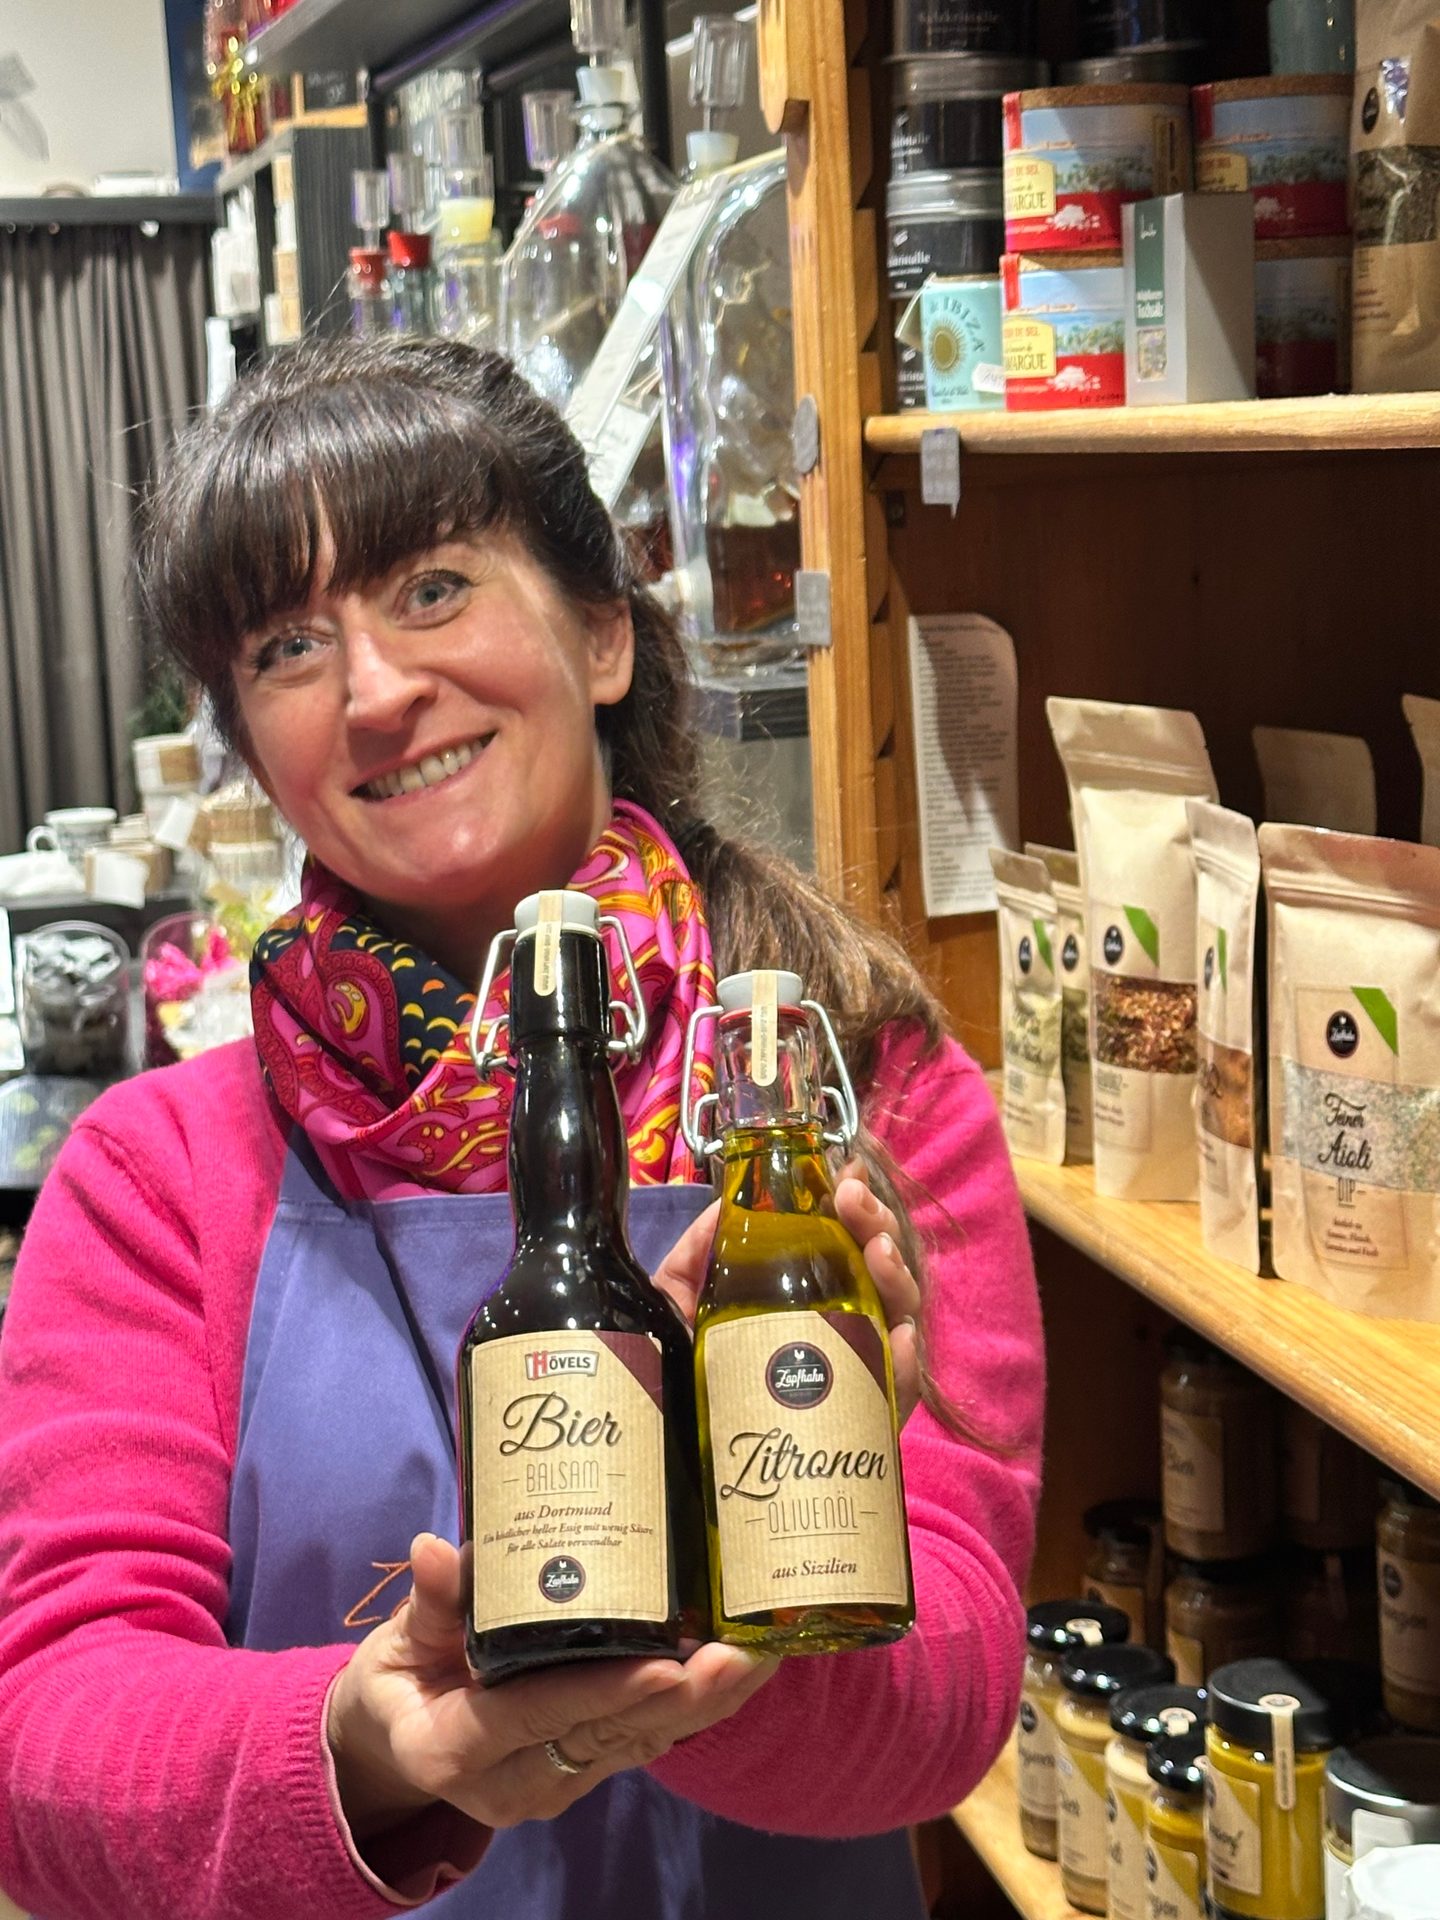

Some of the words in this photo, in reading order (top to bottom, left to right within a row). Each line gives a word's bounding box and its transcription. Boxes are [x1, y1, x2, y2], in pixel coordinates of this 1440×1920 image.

[1324, 1092, 1366, 1129] Feiner
[1318, 1131, 1372, 1170] Aioli
[533, 1350, 591, 1381] HÖVELS
[775, 1368, 825, 1388] Zapfhahn
[499, 1391, 623, 1456] Bier
[526, 1460, 599, 1493] BALSAM
[720, 1427, 888, 1501] Zitronen
[514, 1509, 539, 1521] aus
[539, 1502, 613, 1519] Dortmund
[768, 1490, 858, 1533] OLIVENÖL
[771, 1566, 798, 1580] aus
[800, 1557, 857, 1577] Sizilien
